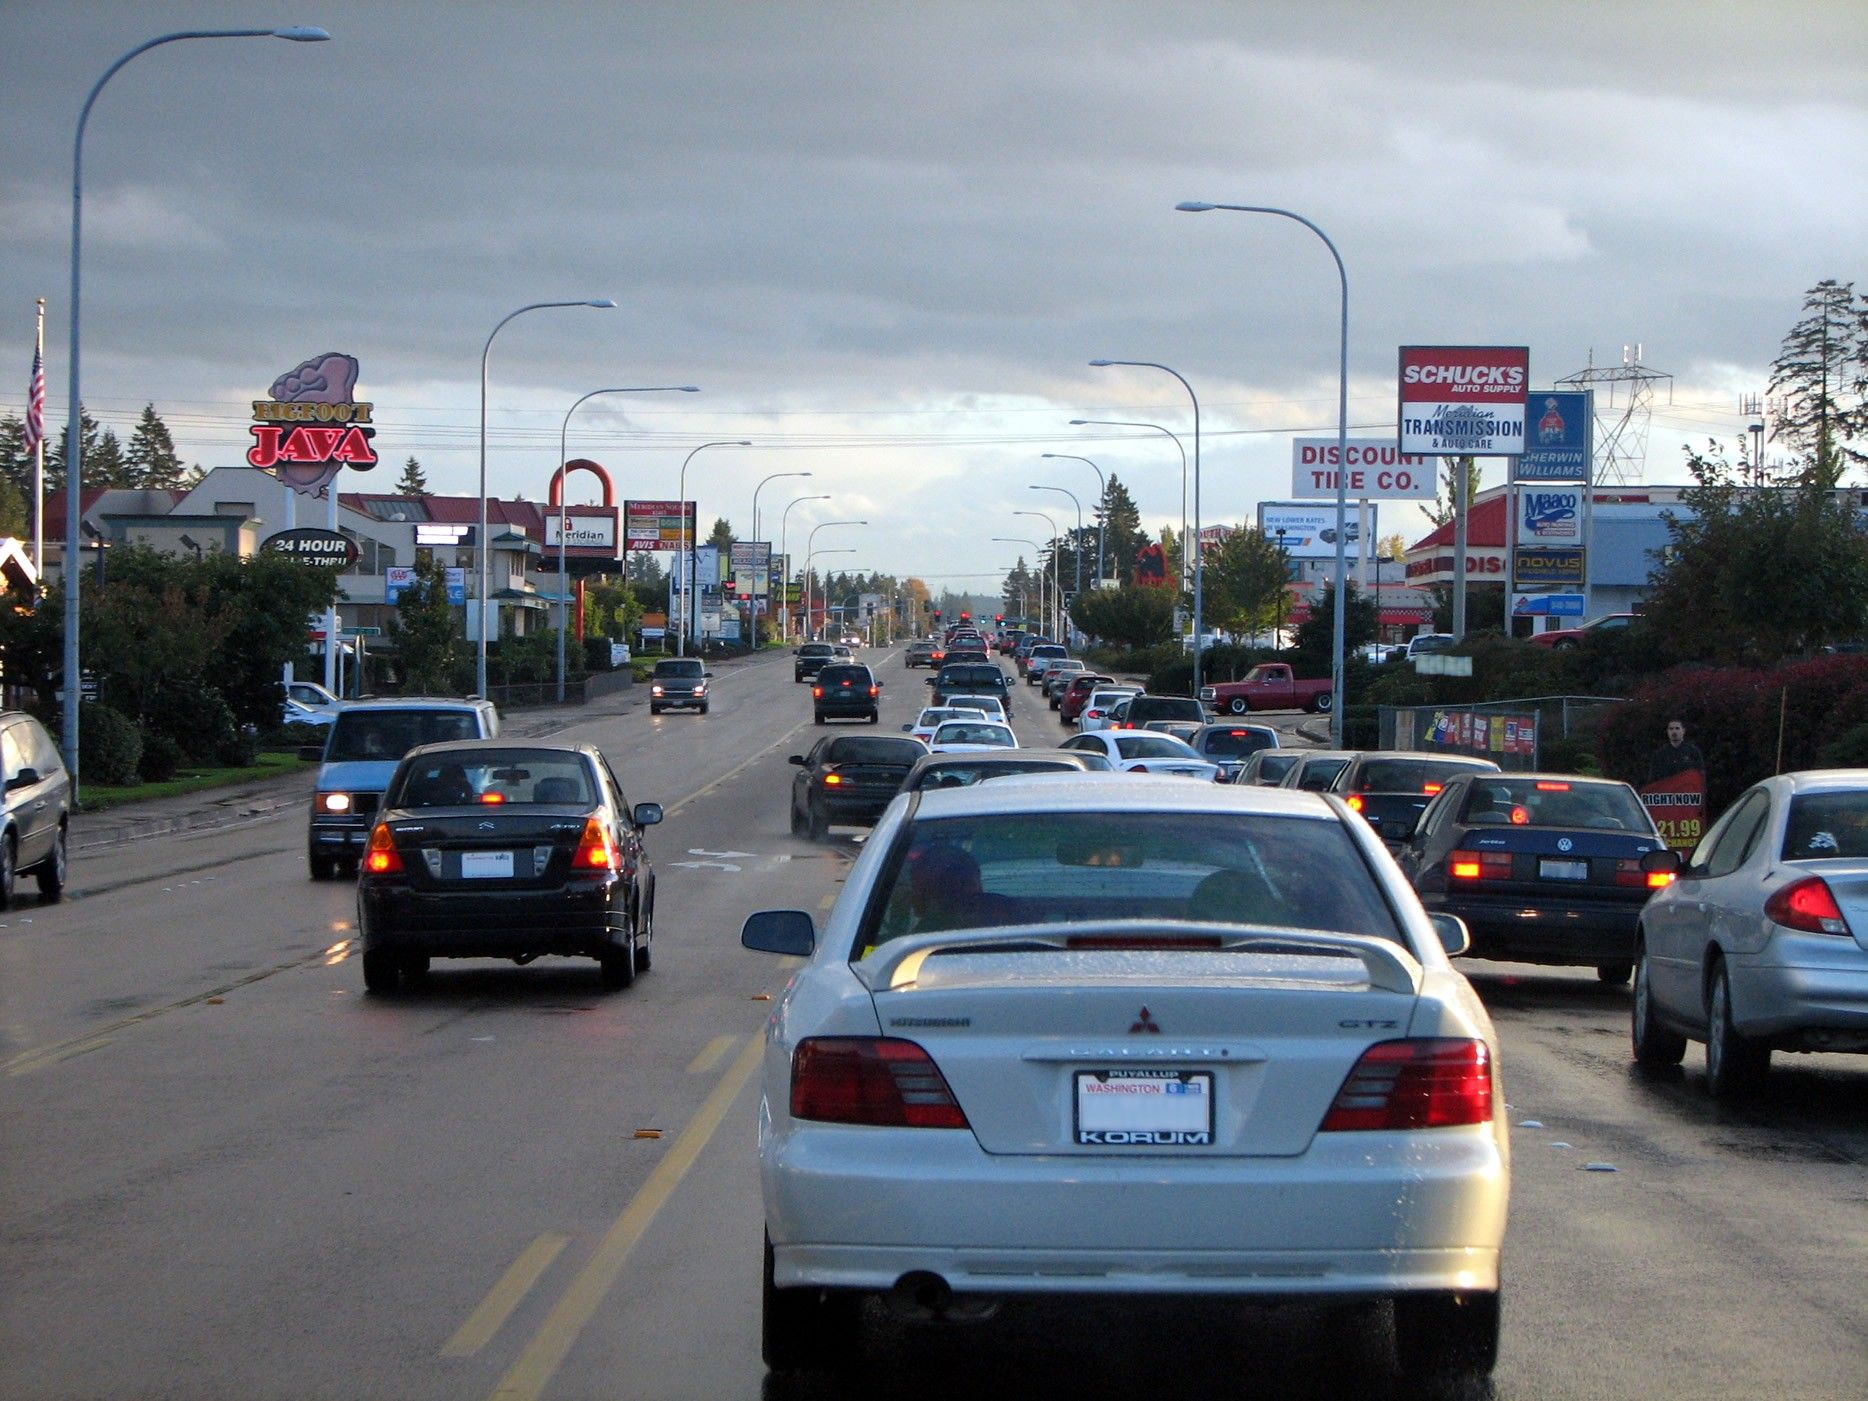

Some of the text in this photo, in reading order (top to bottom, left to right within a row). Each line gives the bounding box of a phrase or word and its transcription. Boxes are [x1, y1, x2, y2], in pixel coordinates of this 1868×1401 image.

[1403, 365, 1524, 385] SCHUCK'S
[1451, 384, 1522, 394] AUTO SUPPLY
[253, 401, 374, 423] BIGFOOT
[1432, 404, 1495, 419] Meridian
[1404, 418, 1523, 437] TRANSMISSION
[247, 426, 377, 468] JAVA
[1432, 438, 1493, 449] & AUTO CARE
[1520, 451, 1584, 463] SHERWIN
[1520, 463, 1584, 477] WILLIAMS
[1377, 471, 1419, 490] CO.
[275, 539, 347, 552] 24 HOUR
[632, 540, 655, 549] AVIS
[1465, 556, 1506, 573] DIS
[1641, 793, 1702, 806] RIGHT NOW
[1657, 818, 1701, 838] 21.99
[1338, 1019, 1398, 1029] GTZ
[1109, 1070, 1179, 1079] PUYALLUP
[1086, 1083, 1161, 1094] WASHINGTON
[1079, 1131, 1209, 1145] KORUM
